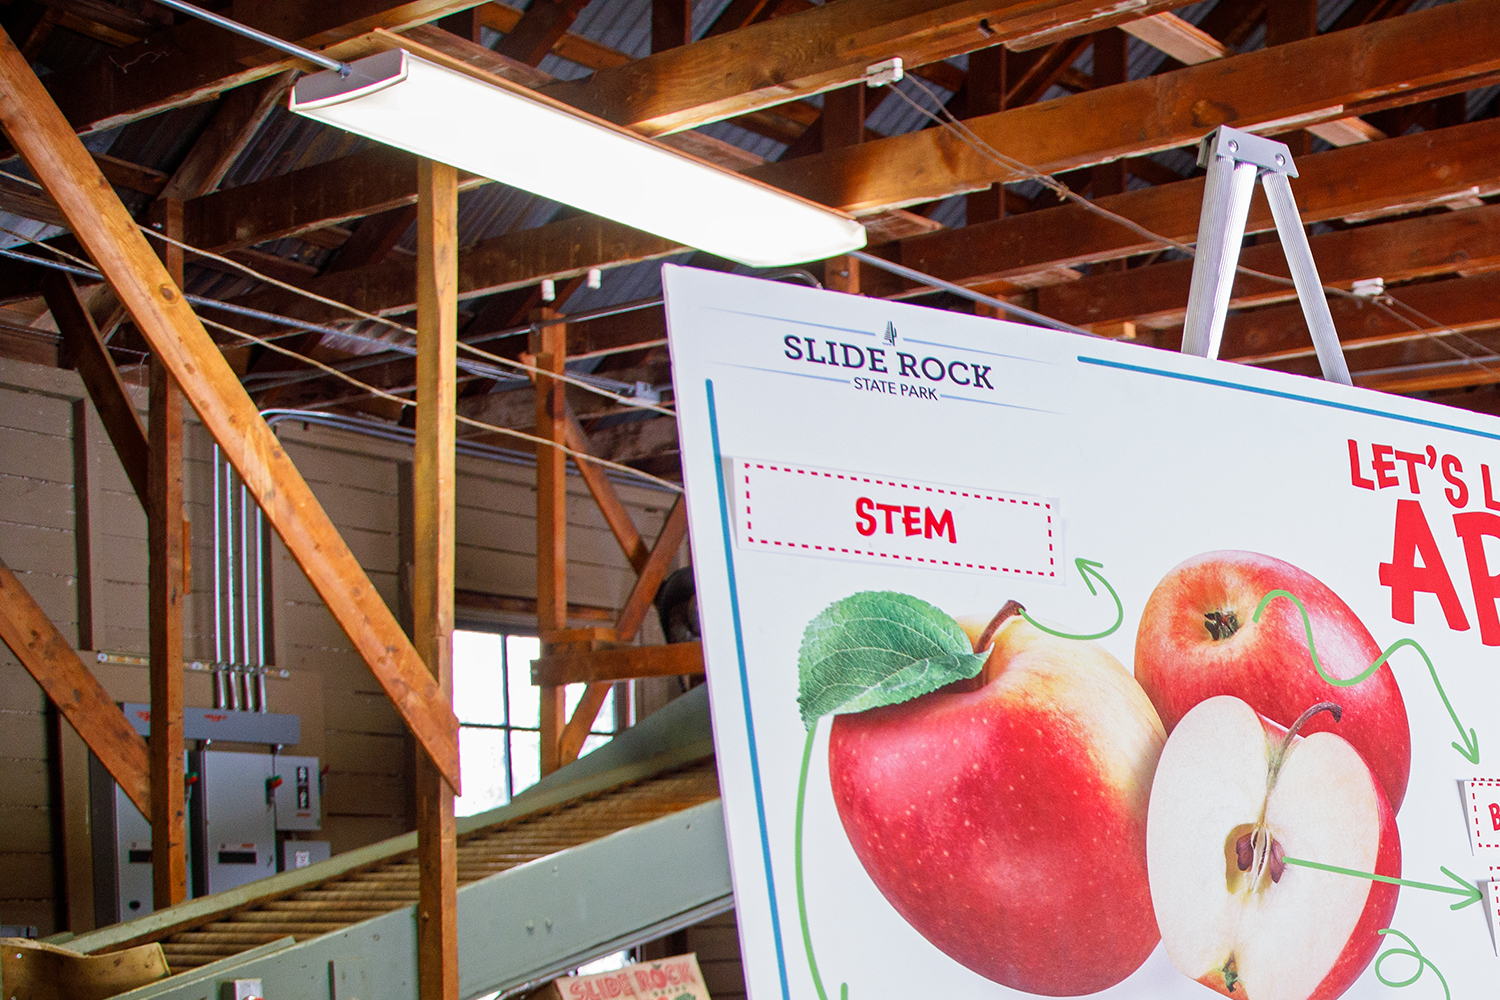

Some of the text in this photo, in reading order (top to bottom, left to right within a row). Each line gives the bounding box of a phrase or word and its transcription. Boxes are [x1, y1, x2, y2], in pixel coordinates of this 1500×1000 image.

[784, 334, 995, 391] SLIDE ROCK
[853, 377, 939, 401] STATE PARK
[855, 496, 958, 545] STEM
[634, 961, 696, 992] ROCK
